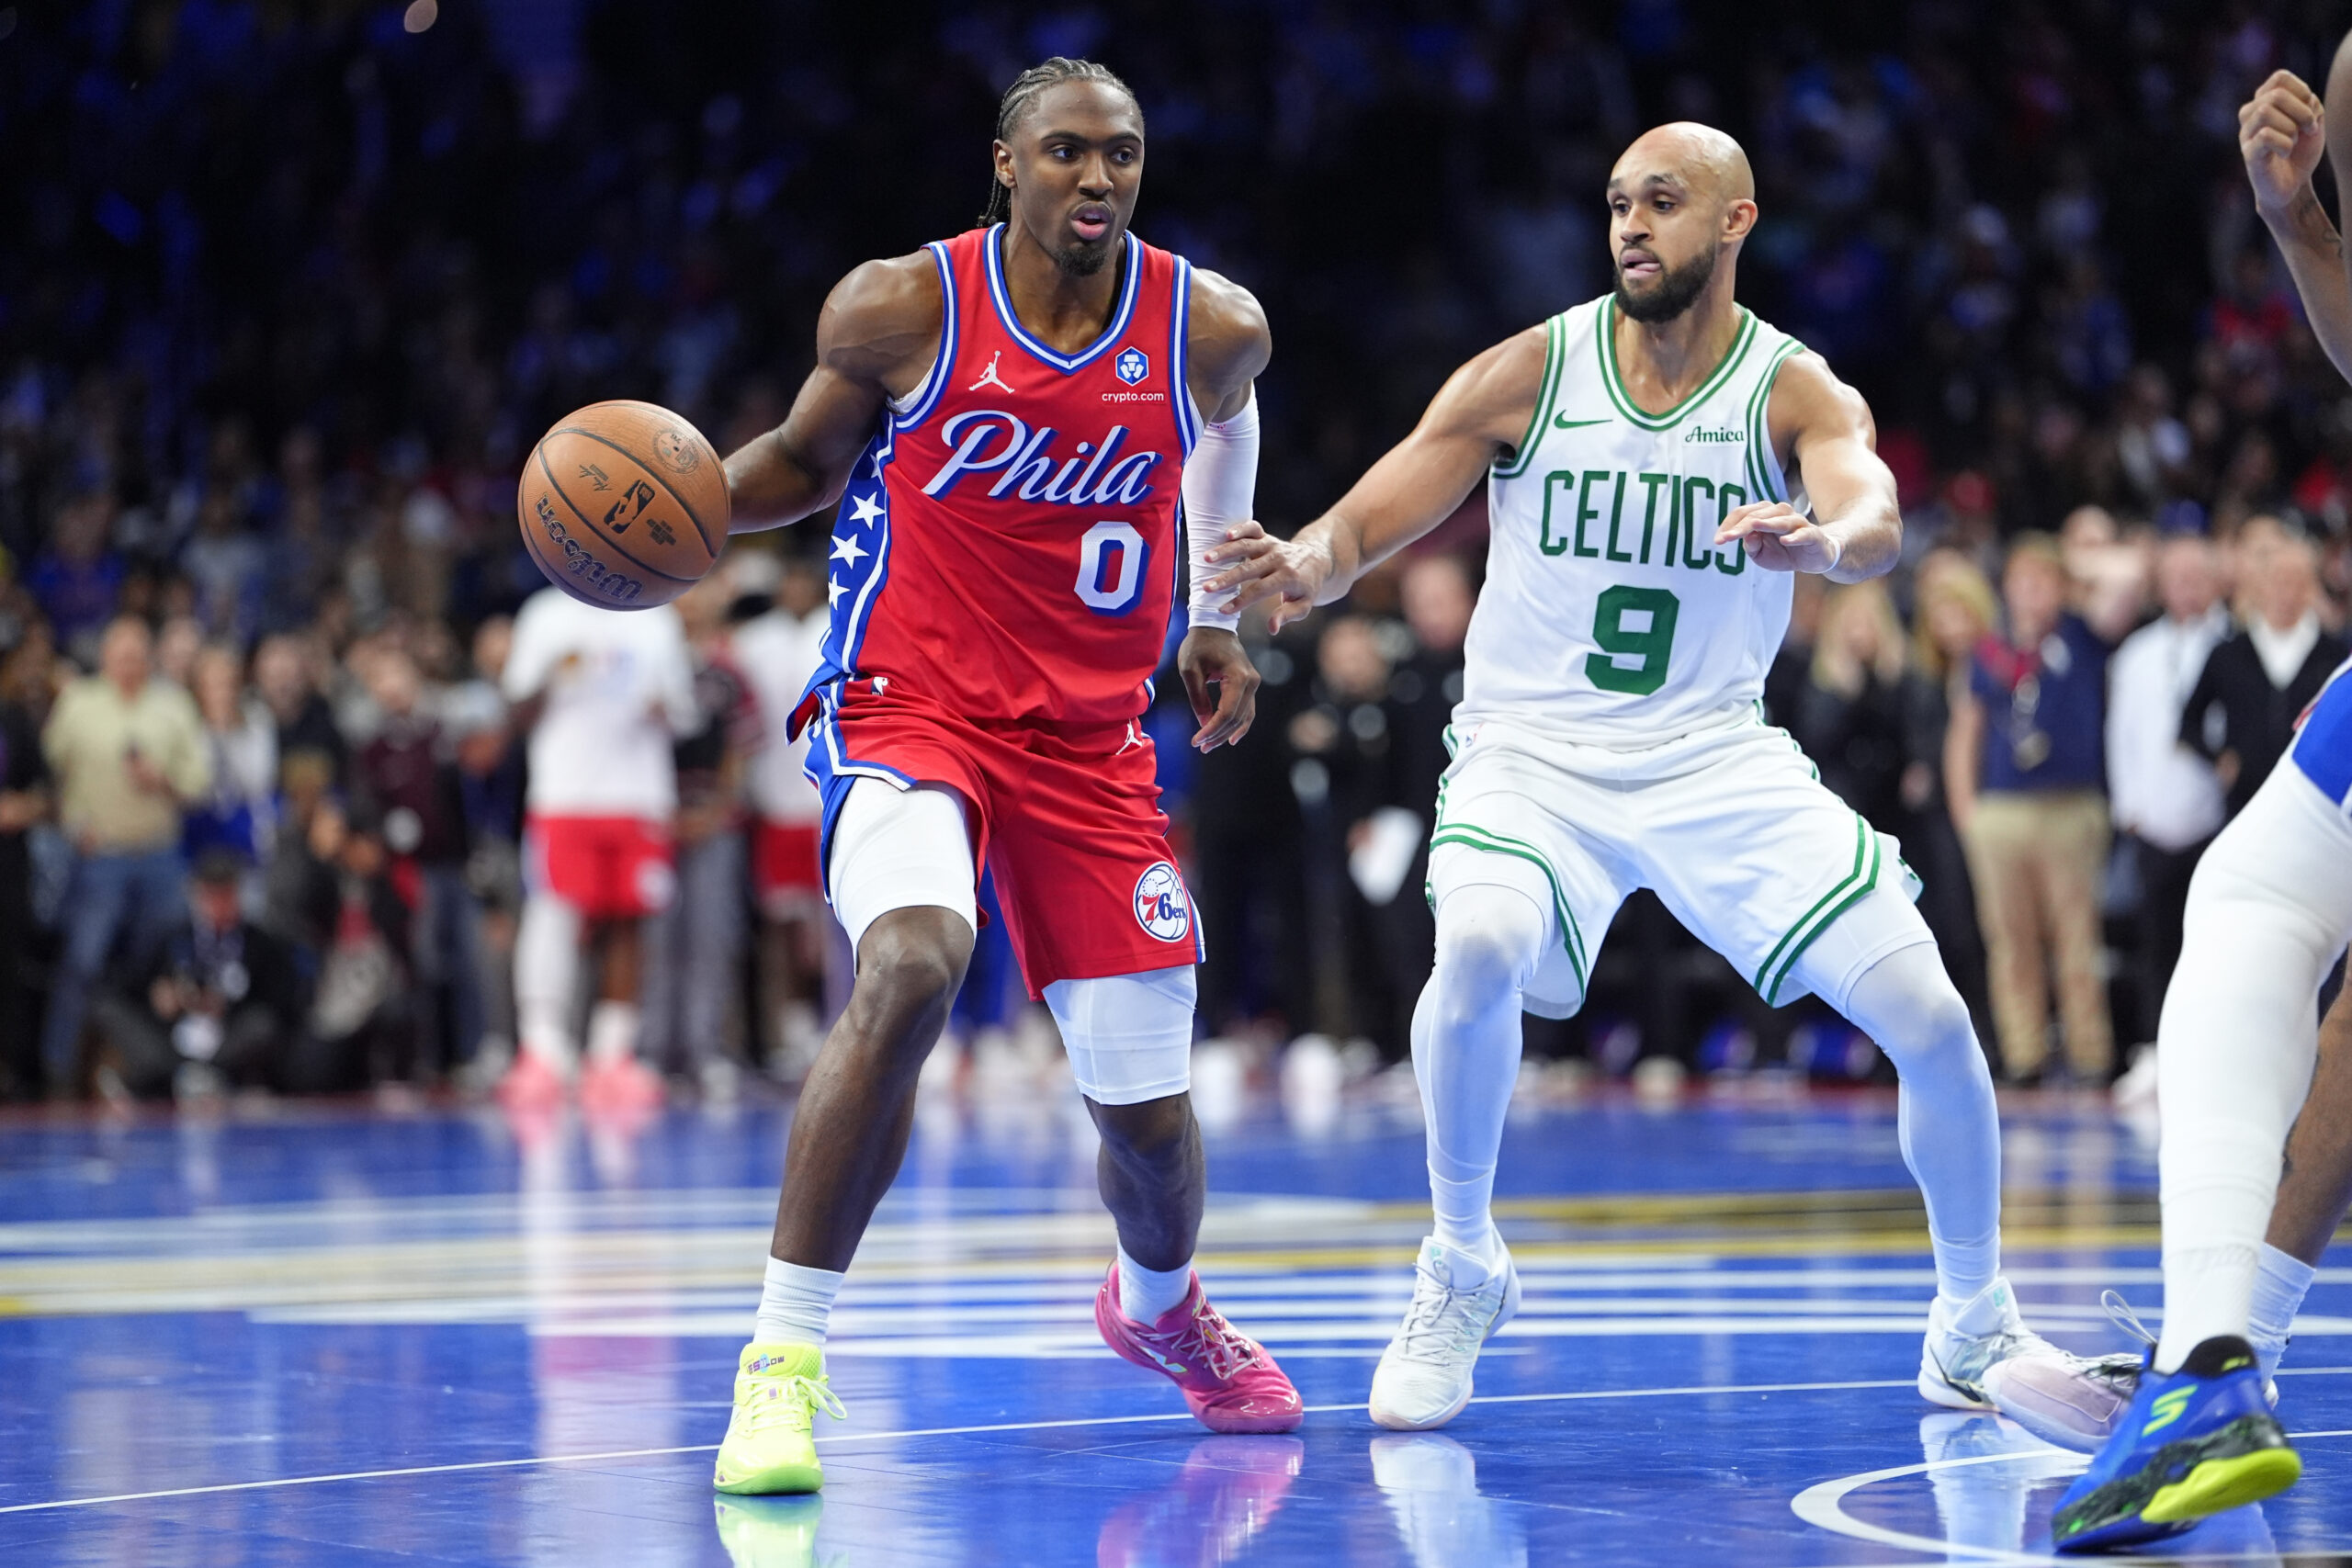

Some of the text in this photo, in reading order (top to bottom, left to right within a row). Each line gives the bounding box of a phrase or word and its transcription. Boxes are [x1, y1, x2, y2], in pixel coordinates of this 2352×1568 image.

[1102, 391, 1165, 402] crypto.com
[921, 410, 1163, 505] Phila
[1685, 425, 1744, 443] Amica
[1073, 521, 1150, 617] 0
[1584, 584, 1680, 695] 9
[1142, 892, 1187, 922] 76ers
